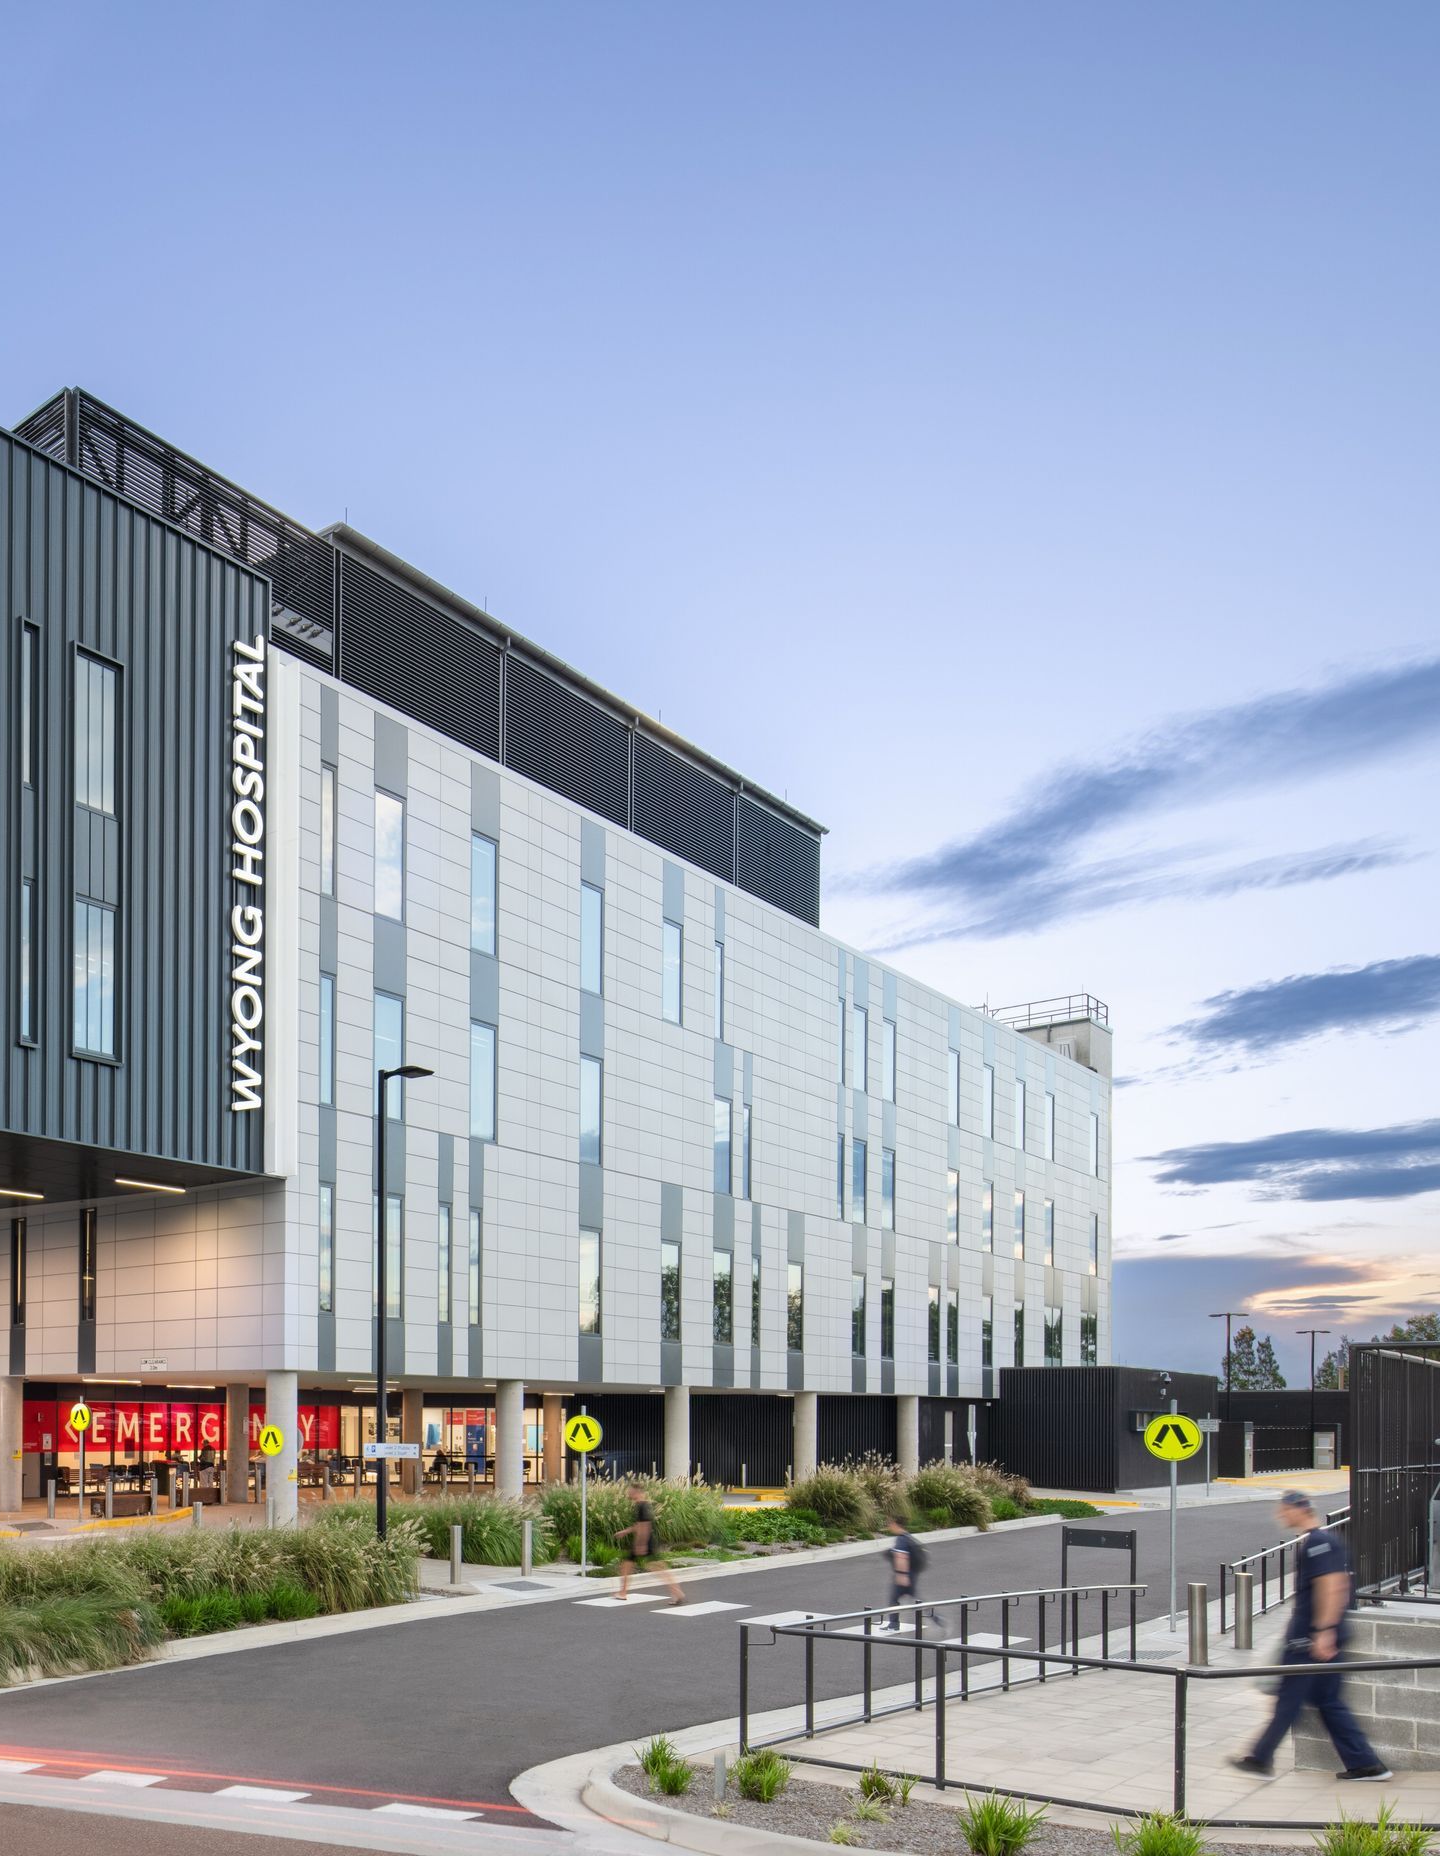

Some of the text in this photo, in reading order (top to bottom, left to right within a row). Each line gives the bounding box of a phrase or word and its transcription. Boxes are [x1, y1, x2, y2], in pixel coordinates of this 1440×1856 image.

[231, 634, 264, 1112] WYONG HOSPITAL
[92, 1411, 315, 1443] EMERGNY
